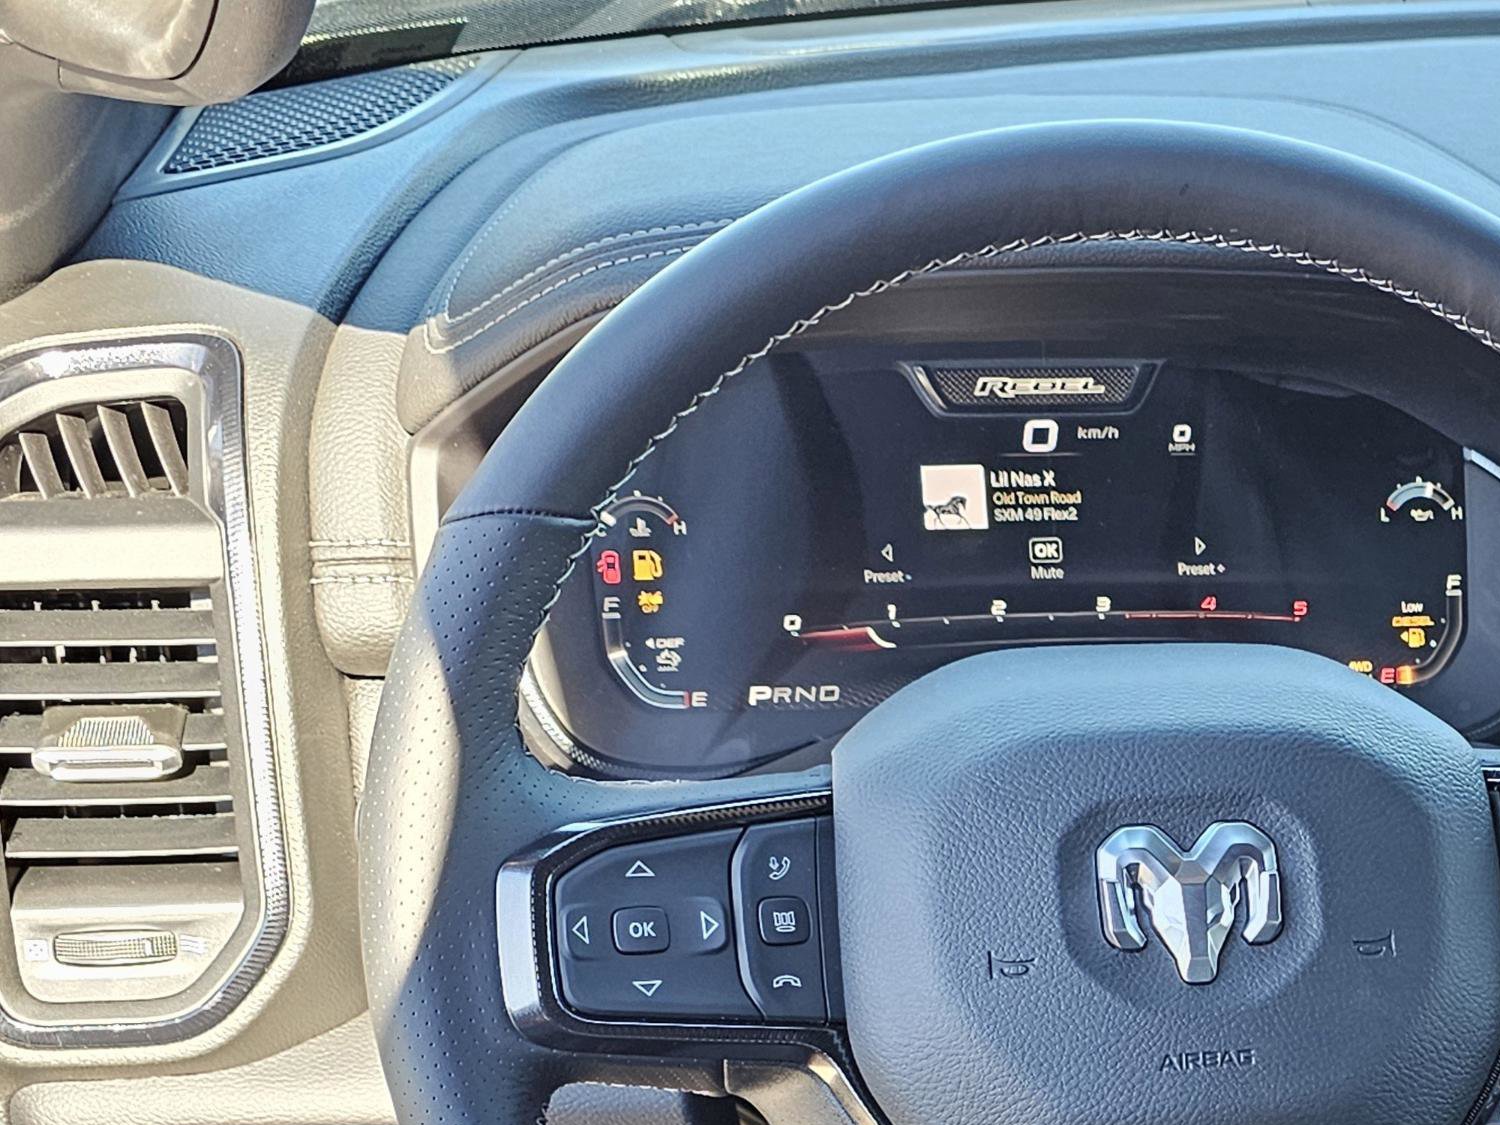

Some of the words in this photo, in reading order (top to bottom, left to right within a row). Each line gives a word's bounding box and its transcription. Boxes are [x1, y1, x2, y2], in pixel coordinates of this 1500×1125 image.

[974, 376, 1106, 399] REBEL
[1077, 426, 1119, 440] km/h
[1168, 442, 1196, 453] MPH
[990, 471, 1009, 487] Lil
[1011, 471, 1042, 487] Nas
[1043, 470, 1056, 487] X
[993, 491, 1016, 505] Old
[1017, 491, 1049, 505] Town
[1050, 490, 1082, 504] Road
[994, 508, 1025, 522] SXM
[1025, 507, 1043, 522] 49
[1044, 506, 1078, 521] Flex2
[1380, 507, 1390, 523] L
[1450, 507, 1463, 521] H
[673, 520, 688, 535] H
[1034, 544, 1059, 559] OK
[1030, 565, 1065, 580] Mute
[1446, 574, 1461, 590] F
[603, 596, 621, 612] F
[990, 599, 1007, 615] 2
[1095, 595, 1111, 612] 3
[1201, 595, 1217, 611] 4
[1293, 601, 1308, 617] 5
[1381, 667, 1396, 684] E
[691, 691, 708, 707] E
[628, 920, 657, 939] OK
[1160, 1048, 1256, 1072] AIRBAG
